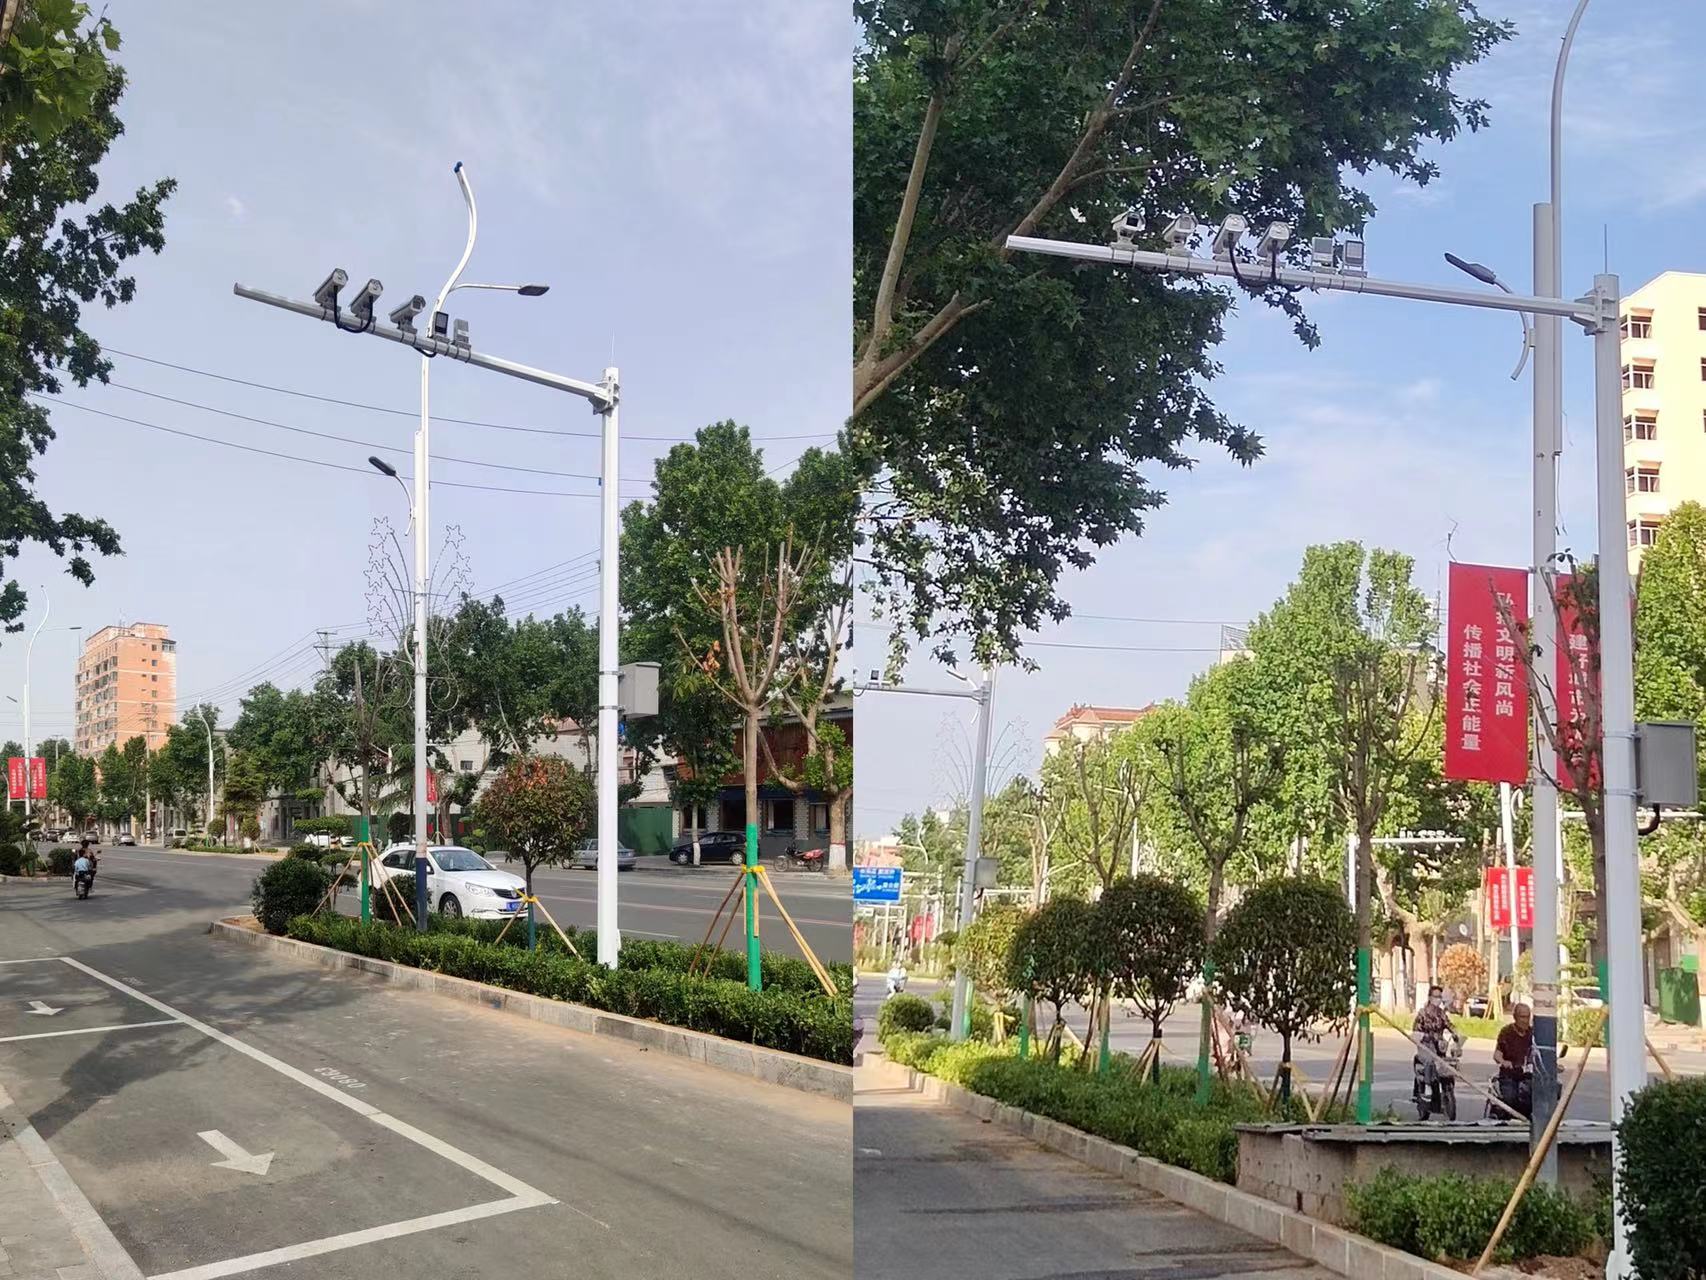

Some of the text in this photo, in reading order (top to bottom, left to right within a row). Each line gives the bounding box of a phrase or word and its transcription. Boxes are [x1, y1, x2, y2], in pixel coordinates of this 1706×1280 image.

[1461, 624, 1483, 751] 传播社会正能量
